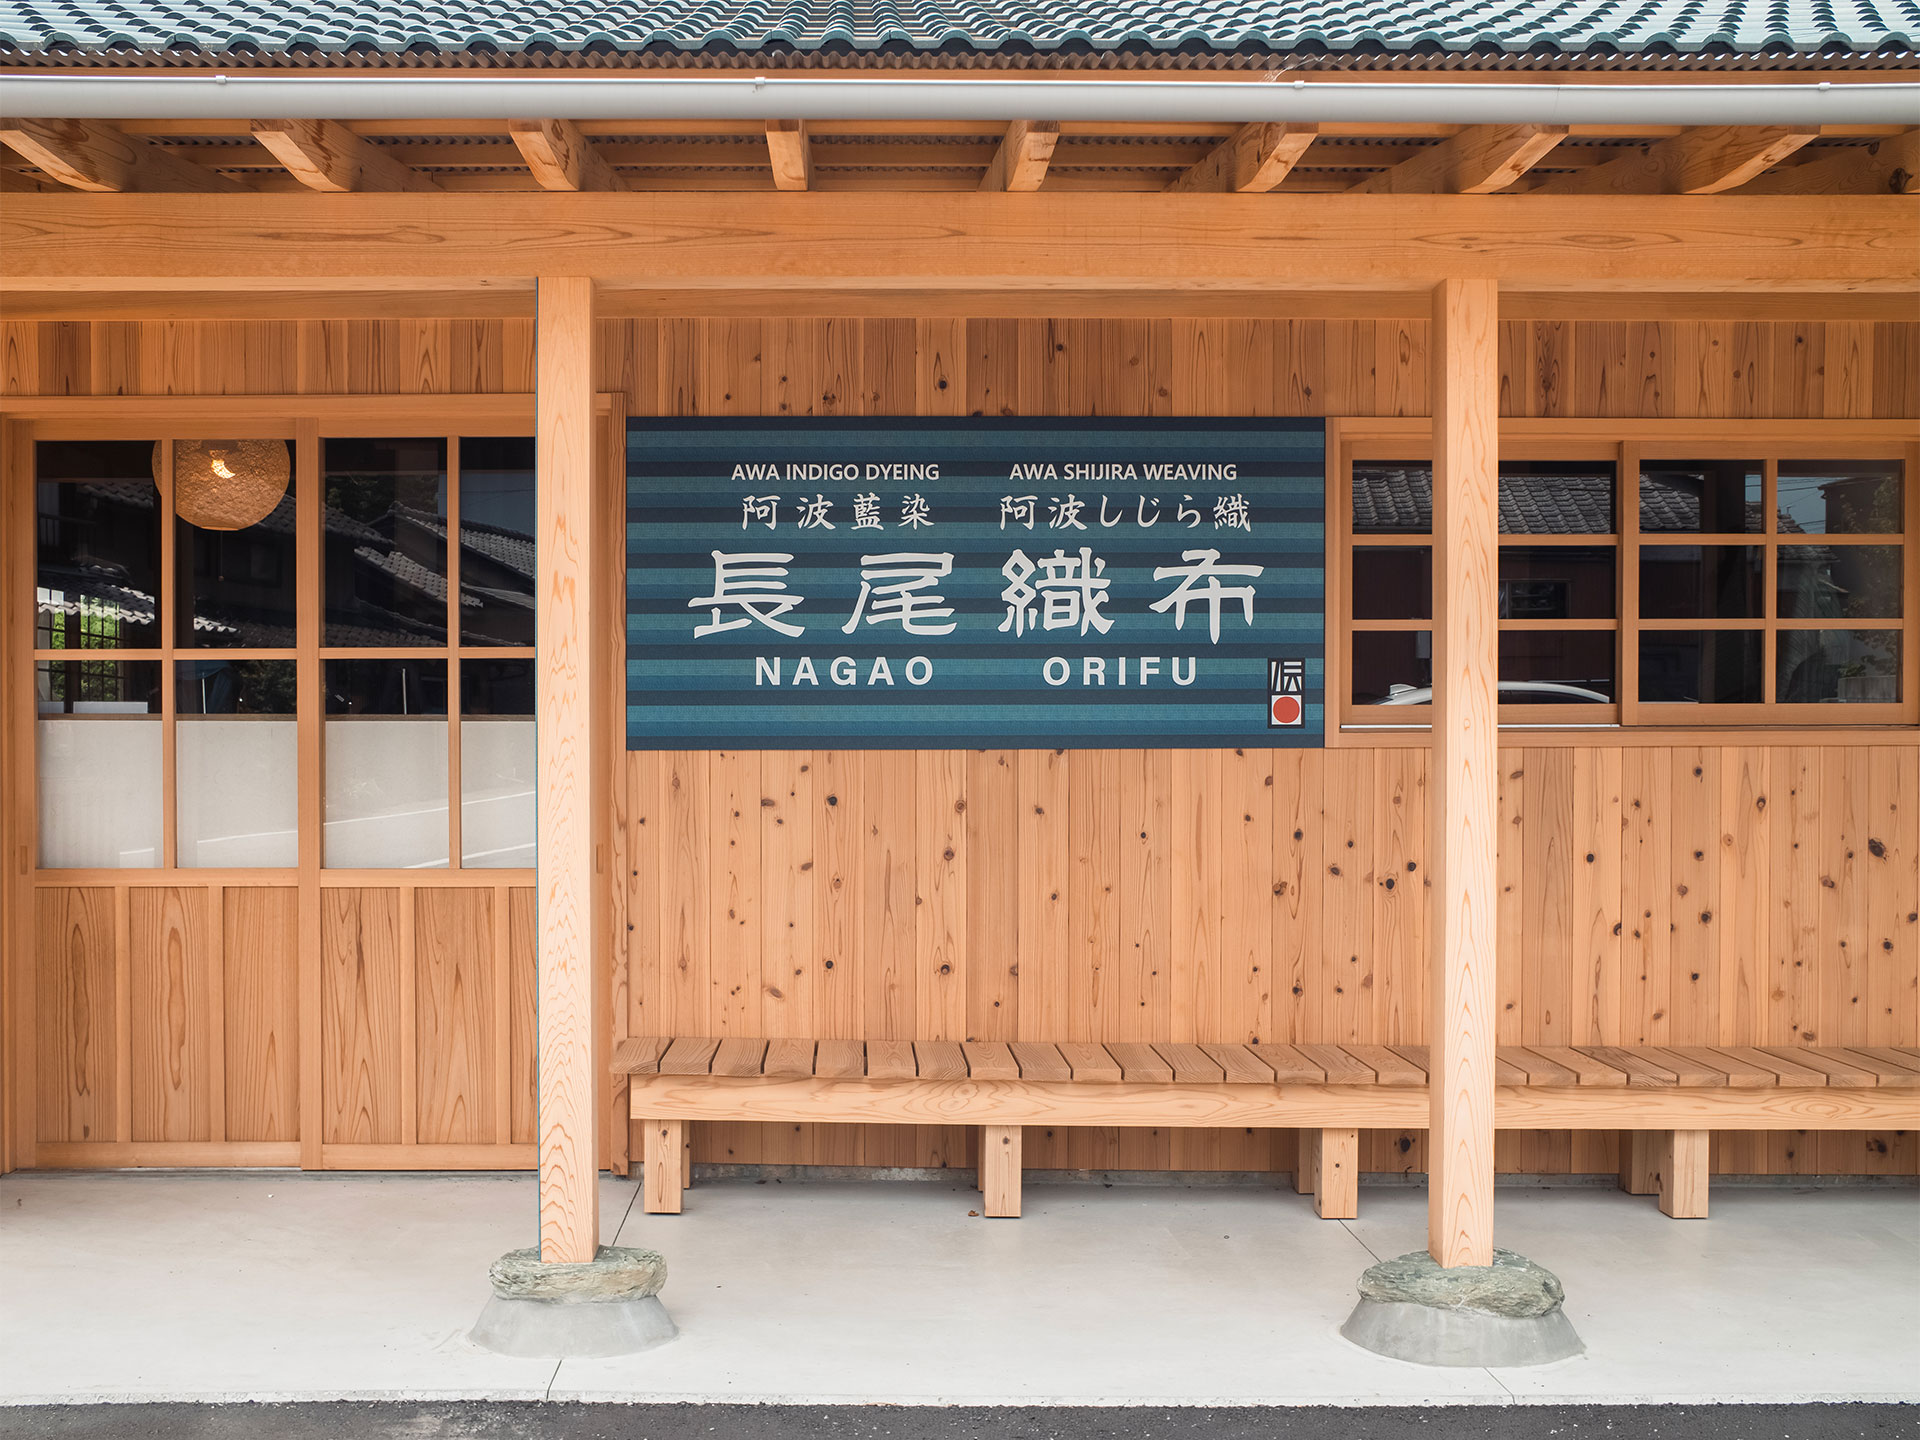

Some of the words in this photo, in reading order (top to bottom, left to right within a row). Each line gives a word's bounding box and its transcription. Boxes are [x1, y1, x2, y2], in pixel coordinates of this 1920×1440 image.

[731, 463, 781, 481] AWA
[786, 463, 860, 481] INDIGO
[866, 463, 941, 481] DYEING
[1009, 463, 1058, 481] AWA
[1063, 463, 1138, 481] SHIJIRA
[1142, 463, 1238, 481] WEAVING
[741, 491, 936, 531] 阿波藍染
[1000, 493, 1252, 533] 阿波しじら織
[687, 546, 1265, 645] 長尾織布
[755, 656, 934, 686] NAGAO
[1042, 656, 1197, 686] ORIFU
